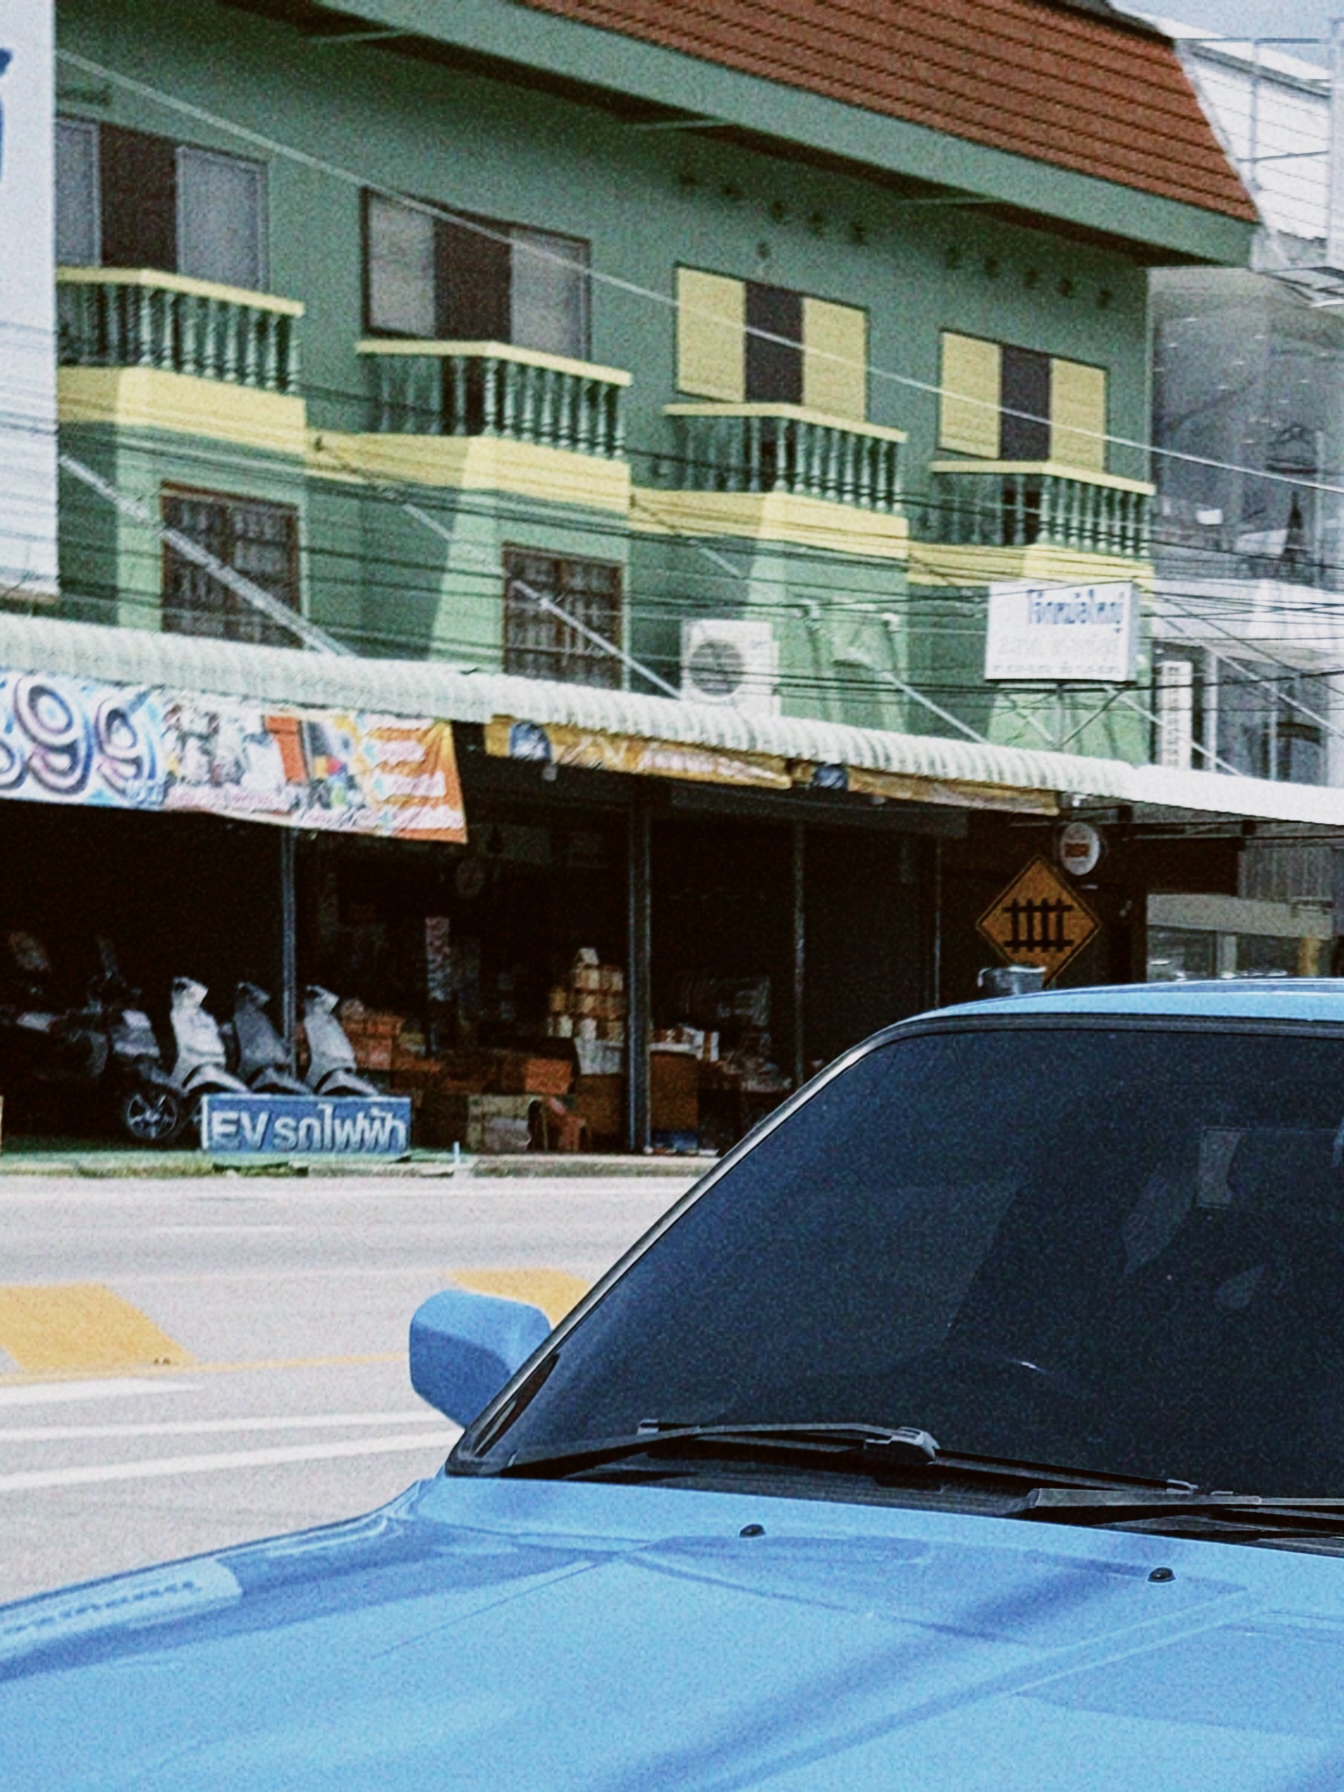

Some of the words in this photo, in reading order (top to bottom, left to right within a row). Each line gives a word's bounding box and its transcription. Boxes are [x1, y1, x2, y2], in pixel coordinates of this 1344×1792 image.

[211, 1109, 270, 1151] EV
[273, 1102, 408, 1151] รถไฟฟ้า
